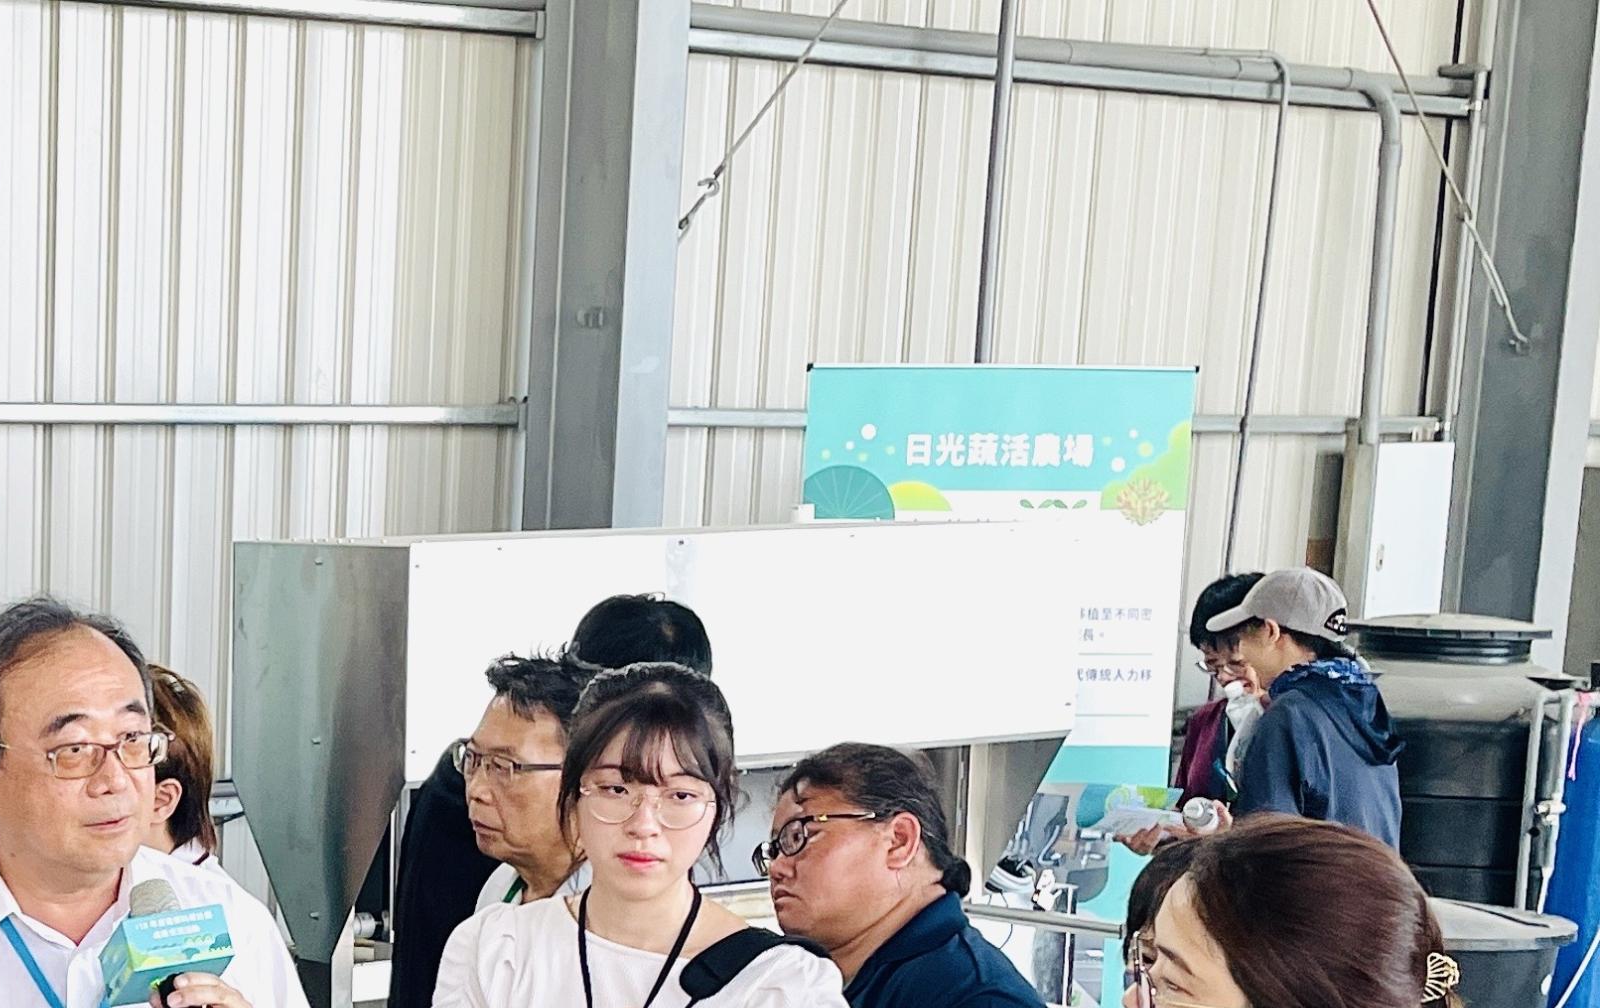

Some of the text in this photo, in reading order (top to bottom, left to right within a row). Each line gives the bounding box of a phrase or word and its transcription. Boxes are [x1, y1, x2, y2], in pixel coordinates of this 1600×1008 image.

[906, 432, 1094, 468] 日光蔬活農場
